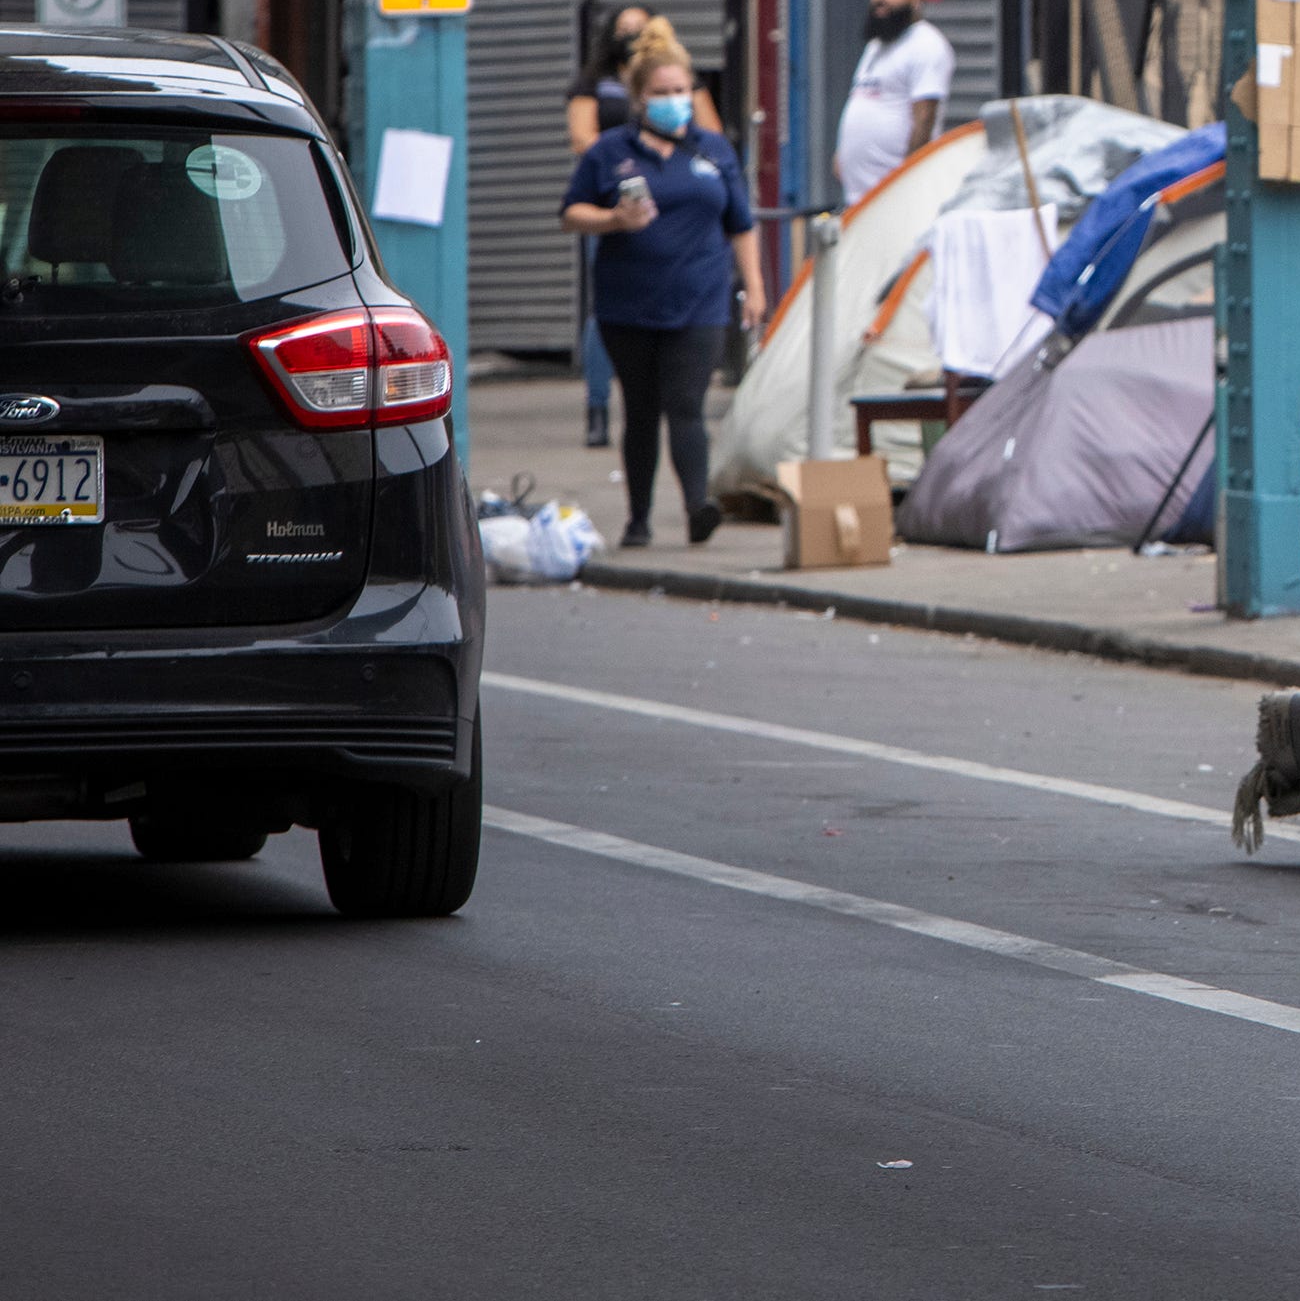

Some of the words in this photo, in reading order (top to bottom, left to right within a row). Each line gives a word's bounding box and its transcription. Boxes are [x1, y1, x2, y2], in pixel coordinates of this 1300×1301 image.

[0, 401, 42, 419] Ford
[0, 443, 58, 454] SYLVANIA
[266, 520, 326, 538] Holman
[246, 550, 344, 564] TITANIUM
